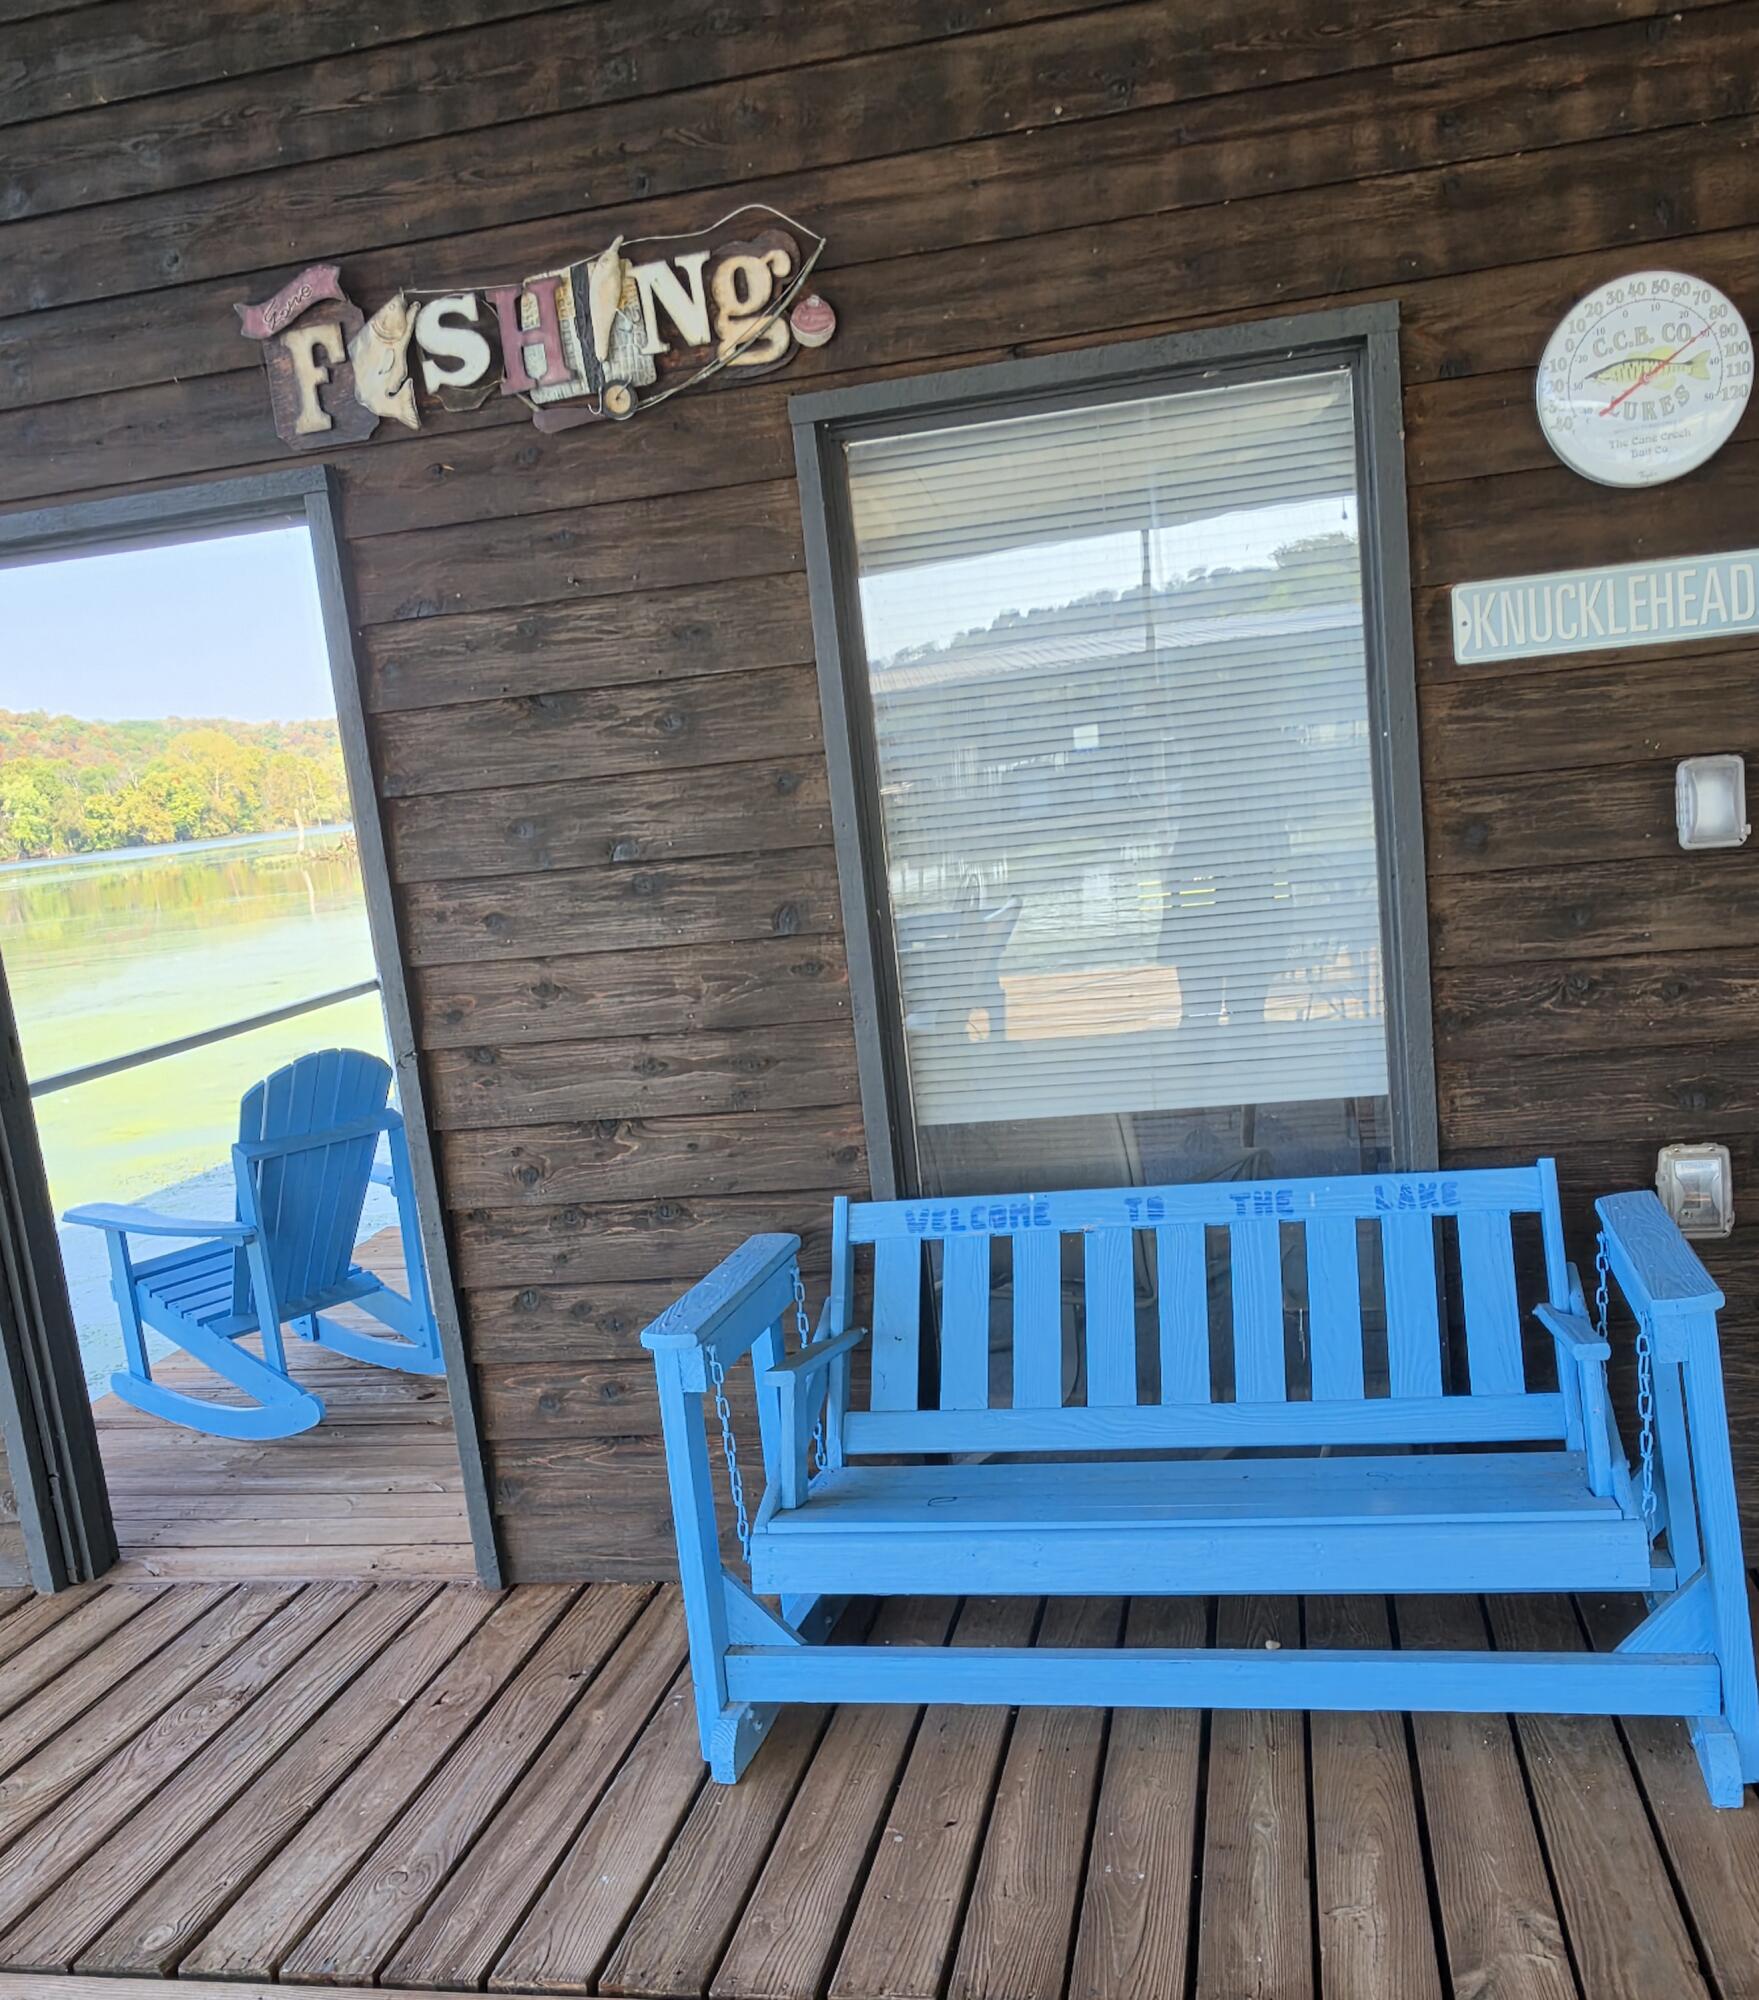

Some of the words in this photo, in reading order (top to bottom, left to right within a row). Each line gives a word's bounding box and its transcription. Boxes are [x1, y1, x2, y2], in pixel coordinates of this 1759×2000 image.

[1627, 281, 1647, 297] 40
[1651, 279, 1670, 295] 50
[1671, 281, 1691, 297] 60
[1606, 289, 1624, 305] 30
[1692, 289, 1712, 306] 70
[263, 284, 312, 331] Gone
[1584, 302, 1604, 318] 20
[1622, 309, 1629, 318] 0
[1650, 303, 1661, 312] 10
[1679, 310, 1689, 319] 20
[1709, 303, 1728, 320] 80
[1568, 319, 1586, 334] 10
[1661, 322, 1692, 343] CO
[1719, 322, 1739, 338] 90
[1565, 338, 1575, 352] 0
[1724, 340, 1749, 357] 100
[1543, 357, 1567, 373] -10
[1709, 356, 1720, 366] 40
[1726, 360, 1751, 378] 110
[1704, 391, 1714, 401] 50
[1721, 384, 1749, 401] 120
[1472, 564, 1755, 649] KNUCKLEHEAD
[905, 1202, 1051, 1233] WELCOME
[1124, 1196, 1165, 1222] TO
[1229, 1189, 1294, 1216] THE
[1374, 1181, 1461, 1210] LAKE
